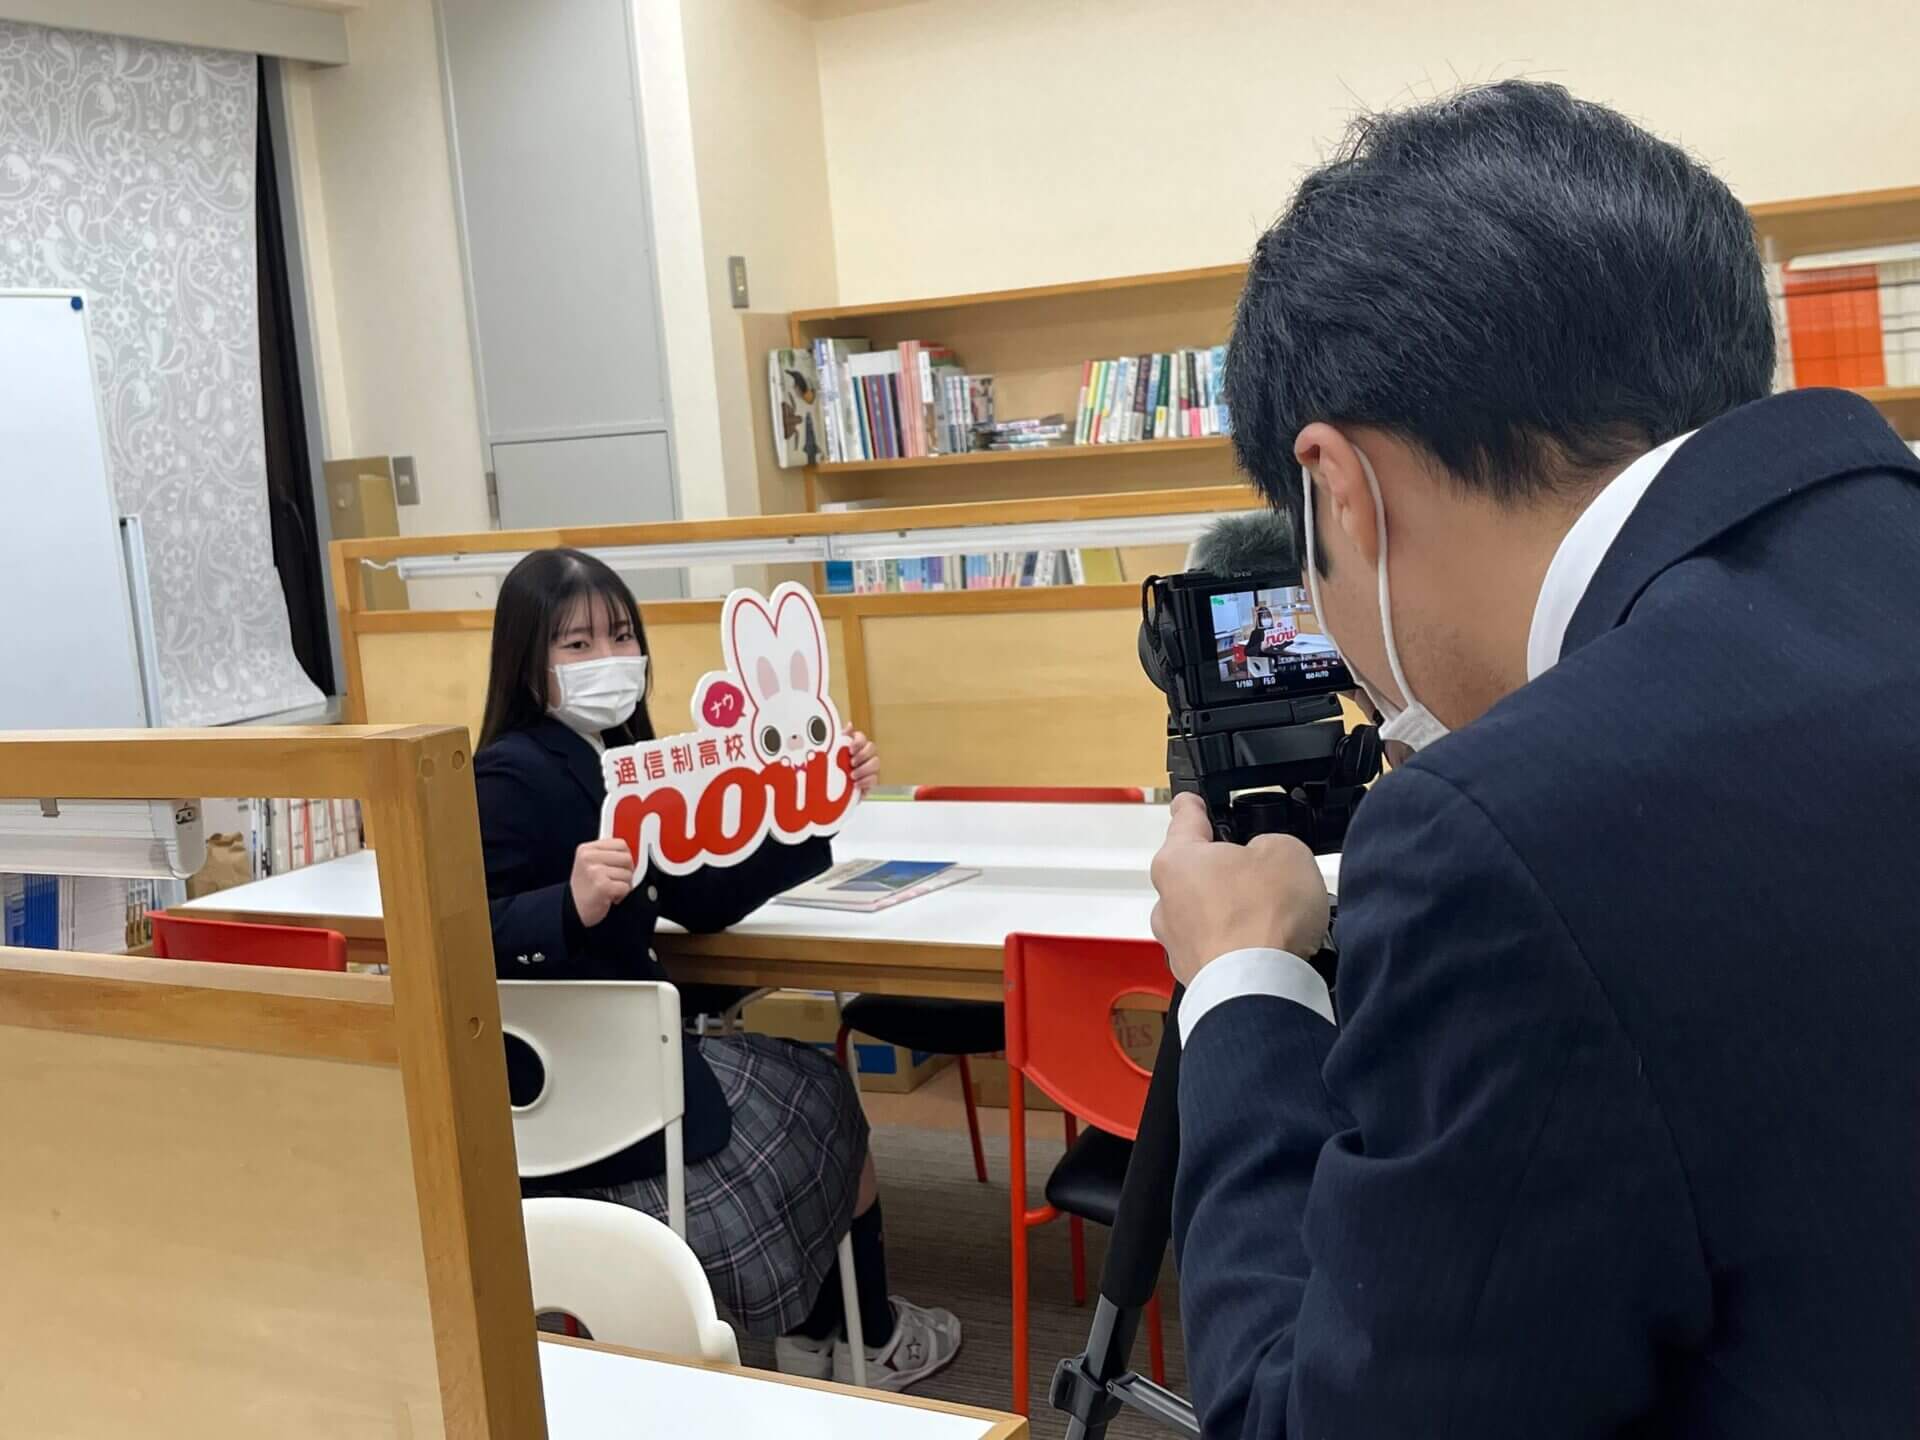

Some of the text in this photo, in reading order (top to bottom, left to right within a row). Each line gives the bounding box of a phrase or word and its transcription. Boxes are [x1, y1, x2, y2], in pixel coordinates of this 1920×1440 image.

[710, 693, 735, 718] ナウ
[613, 734, 747, 786] 通信制高校
[613, 746, 855, 863] now
